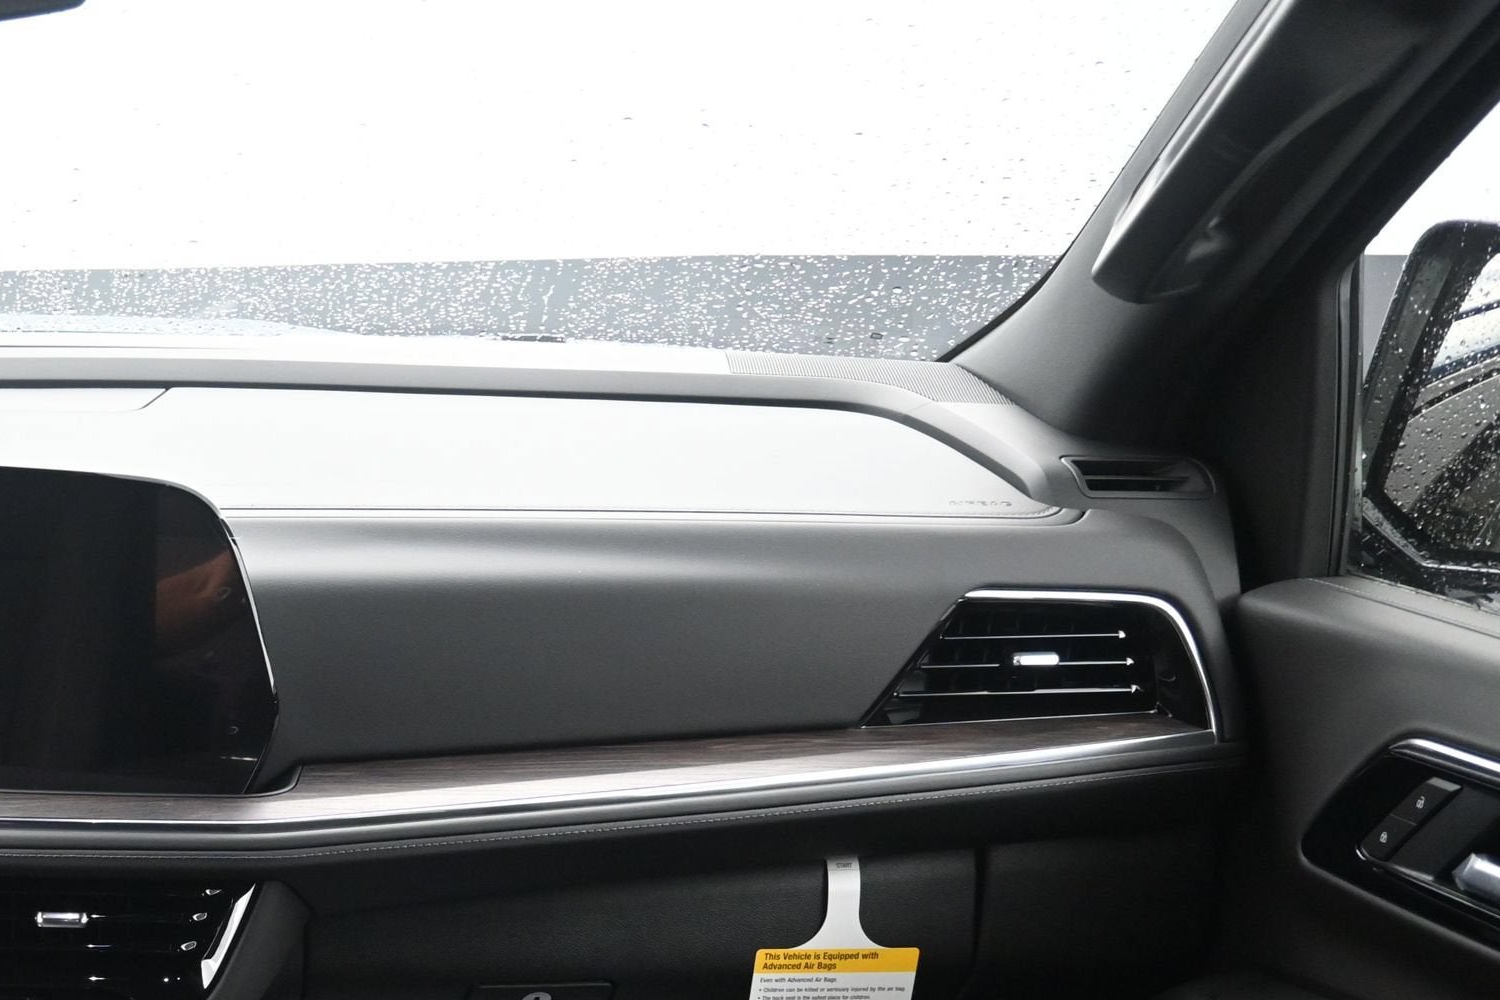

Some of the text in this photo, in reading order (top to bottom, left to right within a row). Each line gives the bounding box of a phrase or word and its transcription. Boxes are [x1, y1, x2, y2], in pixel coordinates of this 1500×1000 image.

[765, 951, 879, 962] This Vehicle is Equipped with
[762, 962, 837, 971] Advanced Air Bags
[823, 976, 837, 984] Bags
